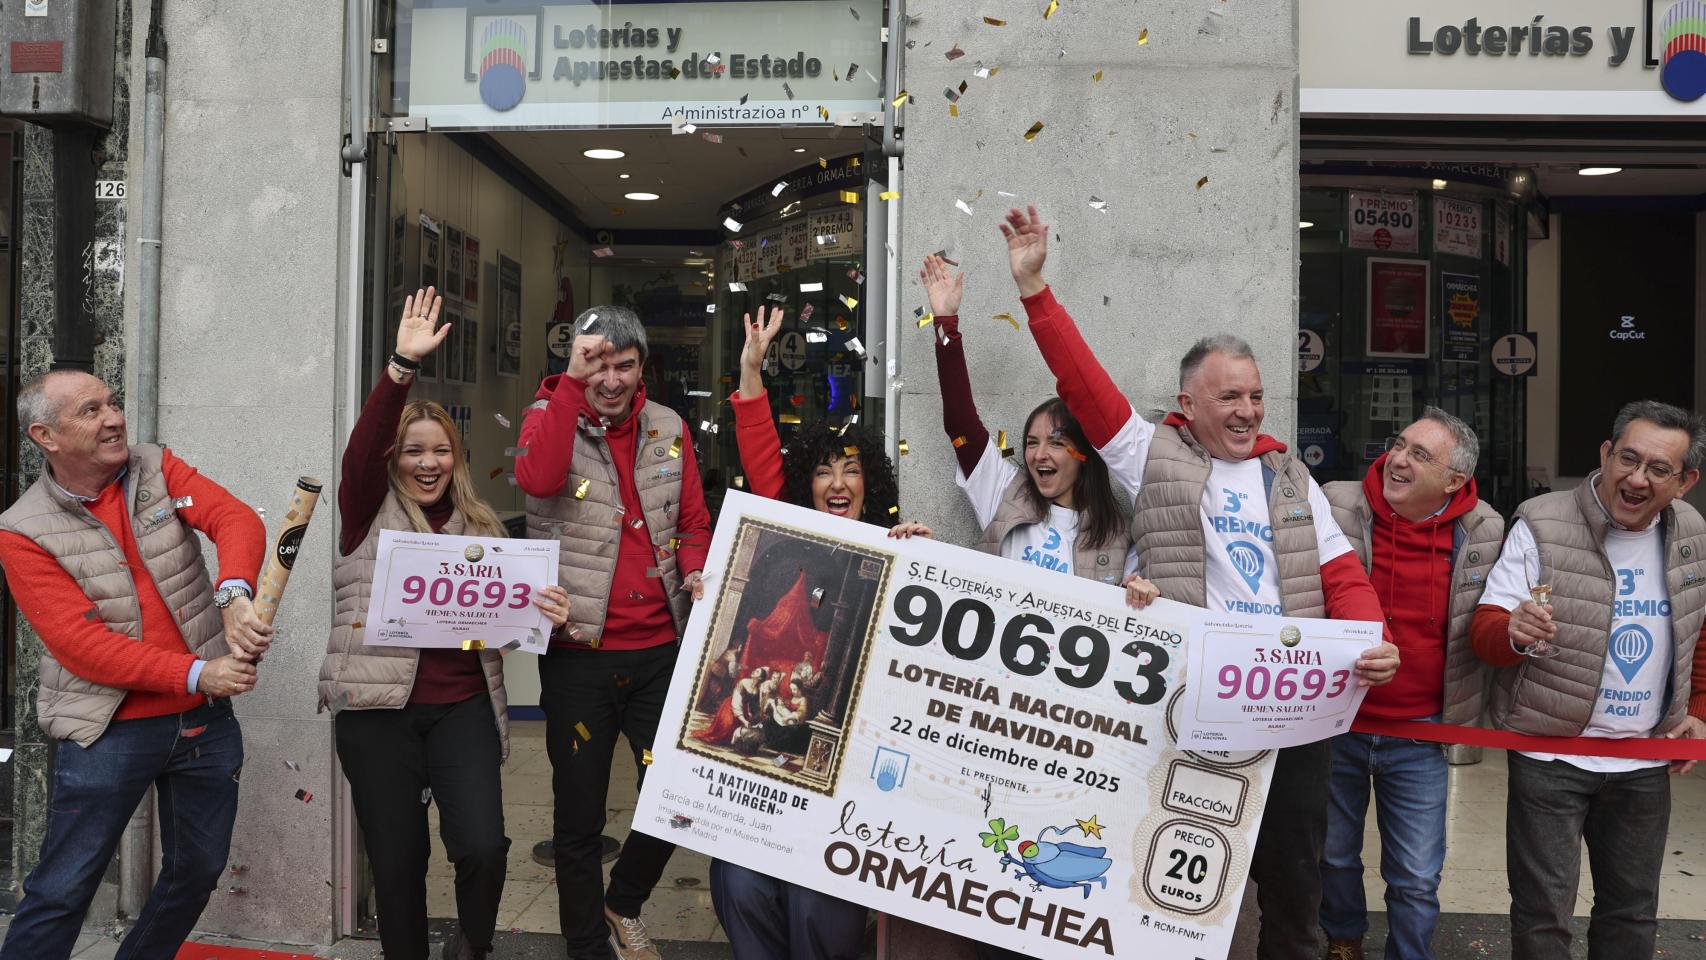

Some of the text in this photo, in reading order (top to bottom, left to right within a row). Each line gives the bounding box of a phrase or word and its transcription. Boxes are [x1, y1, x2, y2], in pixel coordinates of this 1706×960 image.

[553, 22, 682, 52] Loterías y
[1408, 15, 1635, 66] Loterías y
[552, 56, 674, 86] Apuestas
[730, 52, 821, 79] Estado
[662, 105, 785, 121] Administrazioa
[95, 182, 125, 197] 126
[1367, 199, 1408, 211] PREMIO
[816, 212, 850, 225] 43743
[1354, 209, 1412, 229] 05490
[1439, 210, 1477, 229] 10235
[821, 222, 854, 236] PREMIO
[559, 326, 570, 342] 5
[786, 334, 797, 352] 4
[1298, 332, 1311, 353] 2
[1610, 330, 1645, 341] CapCut
[1507, 337, 1516, 356] 1
[1022, 545, 1068, 573] SARIA
[453, 563, 503, 579] SARIA
[401, 575, 532, 610] 90693
[425, 609, 500, 619] HEMEN SALDUTA
[1613, 599, 1672, 617] REMIO
[889, 584, 1171, 706] 90693
[1270, 649, 1323, 666] SARIA
[1217, 664, 1350, 701] 90693
[887, 658, 1149, 746] LOTERÍA NACIONAL
[1241, 704, 1316, 713] HEMEN SALDUTA
[1605, 704, 1640, 717] AQUÍ
[926, 698, 1095, 759] DE NAVIDAD
[889, 716, 1121, 793] 22 de diciembre de 2025
[708, 783, 725, 798] LA
[961, 766, 1030, 795] EL PRESIDENTE,
[718, 771, 788, 806] NATIVIDAD
[792, 795, 809, 811] DE
[661, 788, 690, 807] García
[692, 799, 705, 811] de
[705, 803, 746, 826] Miranda,
[749, 818, 772, 833] Juan
[1172, 791, 1233, 816] FRACCIÓN
[655, 815, 666, 824] del
[692, 826, 718, 842] Madrid
[711, 821, 724, 831] por
[724, 826, 732, 834] el
[733, 829, 760, 844] Museo
[760, 837, 793, 854] Nacional
[829, 799, 977, 874] lotería
[1174, 829, 1215, 849] PRECIO
[1165, 848, 1208, 885] 20
[824, 841, 1116, 956] ORMAECHEA
[1160, 884, 1202, 903] EUROS
[1153, 921, 1206, 941] RCM-FNMT
